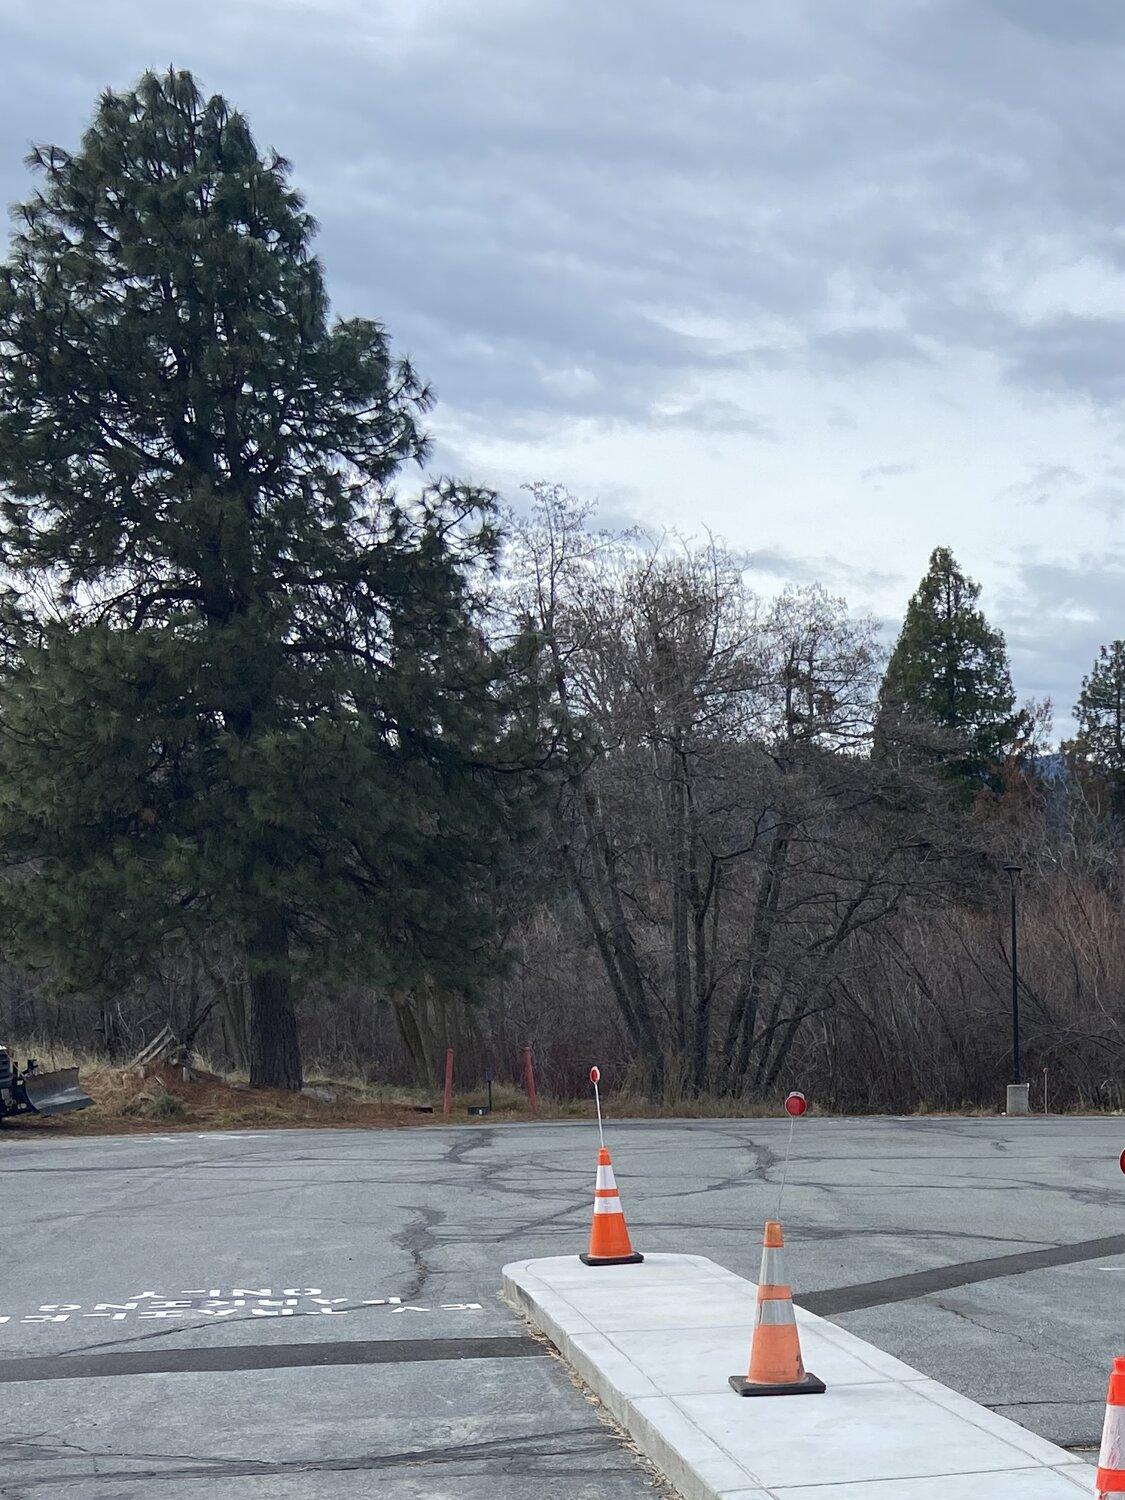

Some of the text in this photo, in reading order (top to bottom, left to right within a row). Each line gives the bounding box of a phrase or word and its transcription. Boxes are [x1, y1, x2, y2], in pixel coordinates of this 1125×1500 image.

[128, 1288, 322, 1300] ONLY
[38, 1296, 402, 1312] PARKING
[391, 1302, 483, 1313] EV
